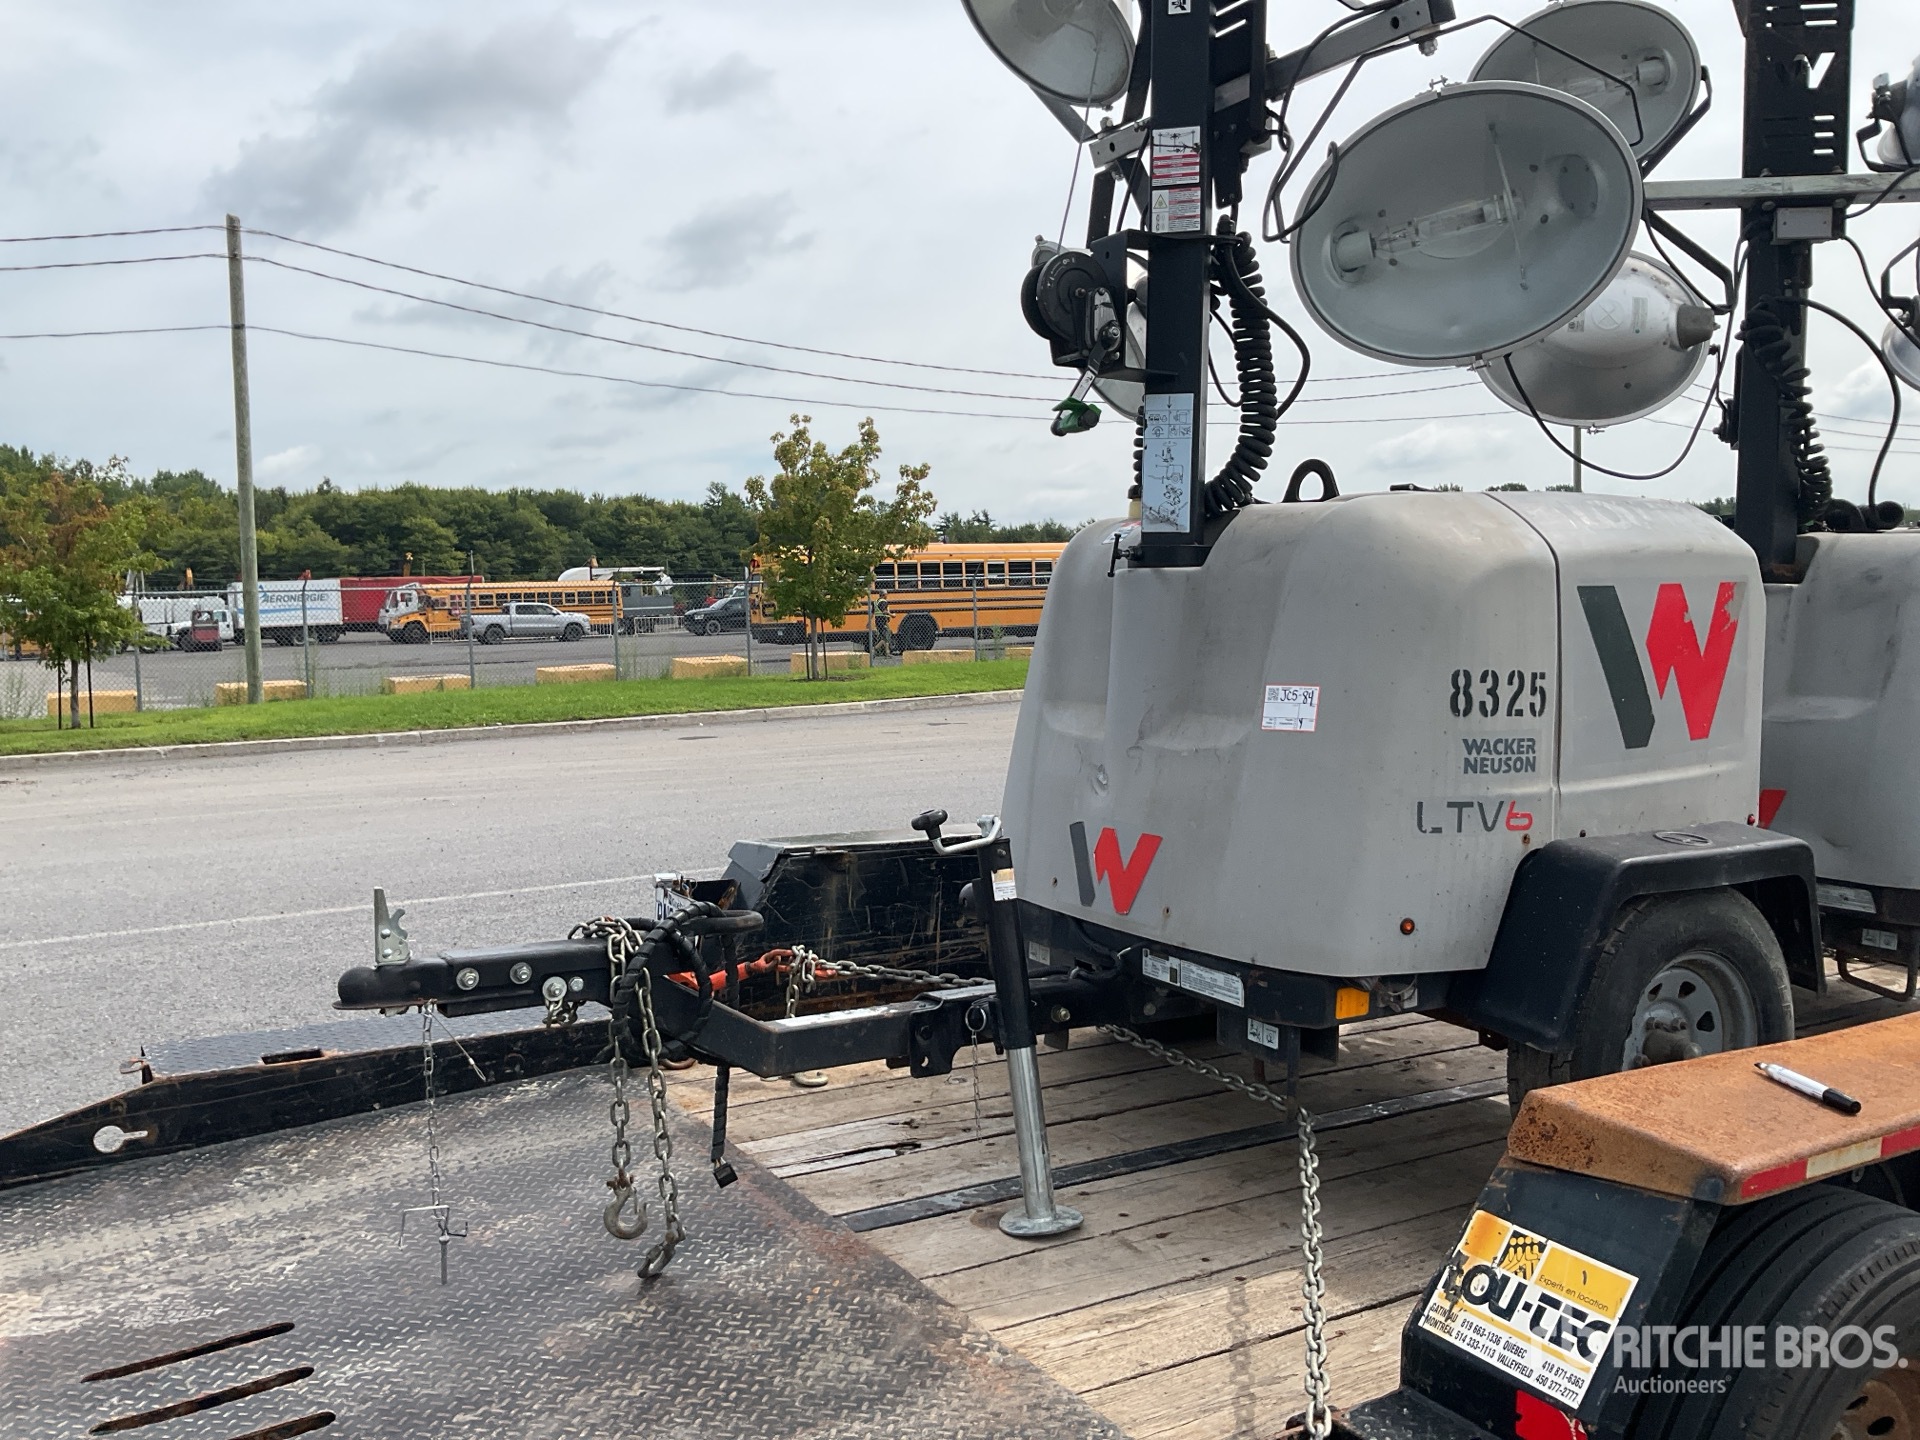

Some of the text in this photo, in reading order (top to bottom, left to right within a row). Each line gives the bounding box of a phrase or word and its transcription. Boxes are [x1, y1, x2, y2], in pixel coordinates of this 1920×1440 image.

[1449, 669, 1546, 717] 8325
[1462, 738, 1536, 755] WACKER
[1463, 756, 1536, 774] NEUSON
[1416, 801, 1533, 833] LTV6
[1443, 1262, 1612, 1364] OU-TEC
[1538, 1274, 1609, 1313] Experts en location
[1430, 1302, 1459, 1322] GATINAU
[1460, 1318, 1474, 1331] 819
[1472, 1324, 1501, 1346] 663-1336
[1541, 1360, 1556, 1375] 418
[1554, 1366, 1585, 1390] 871-6363
[1454, 1330, 1468, 1343] 514
[1496, 1352, 1534, 1379] VALLEYFIELD
[1535, 1373, 1549, 1387] 450
